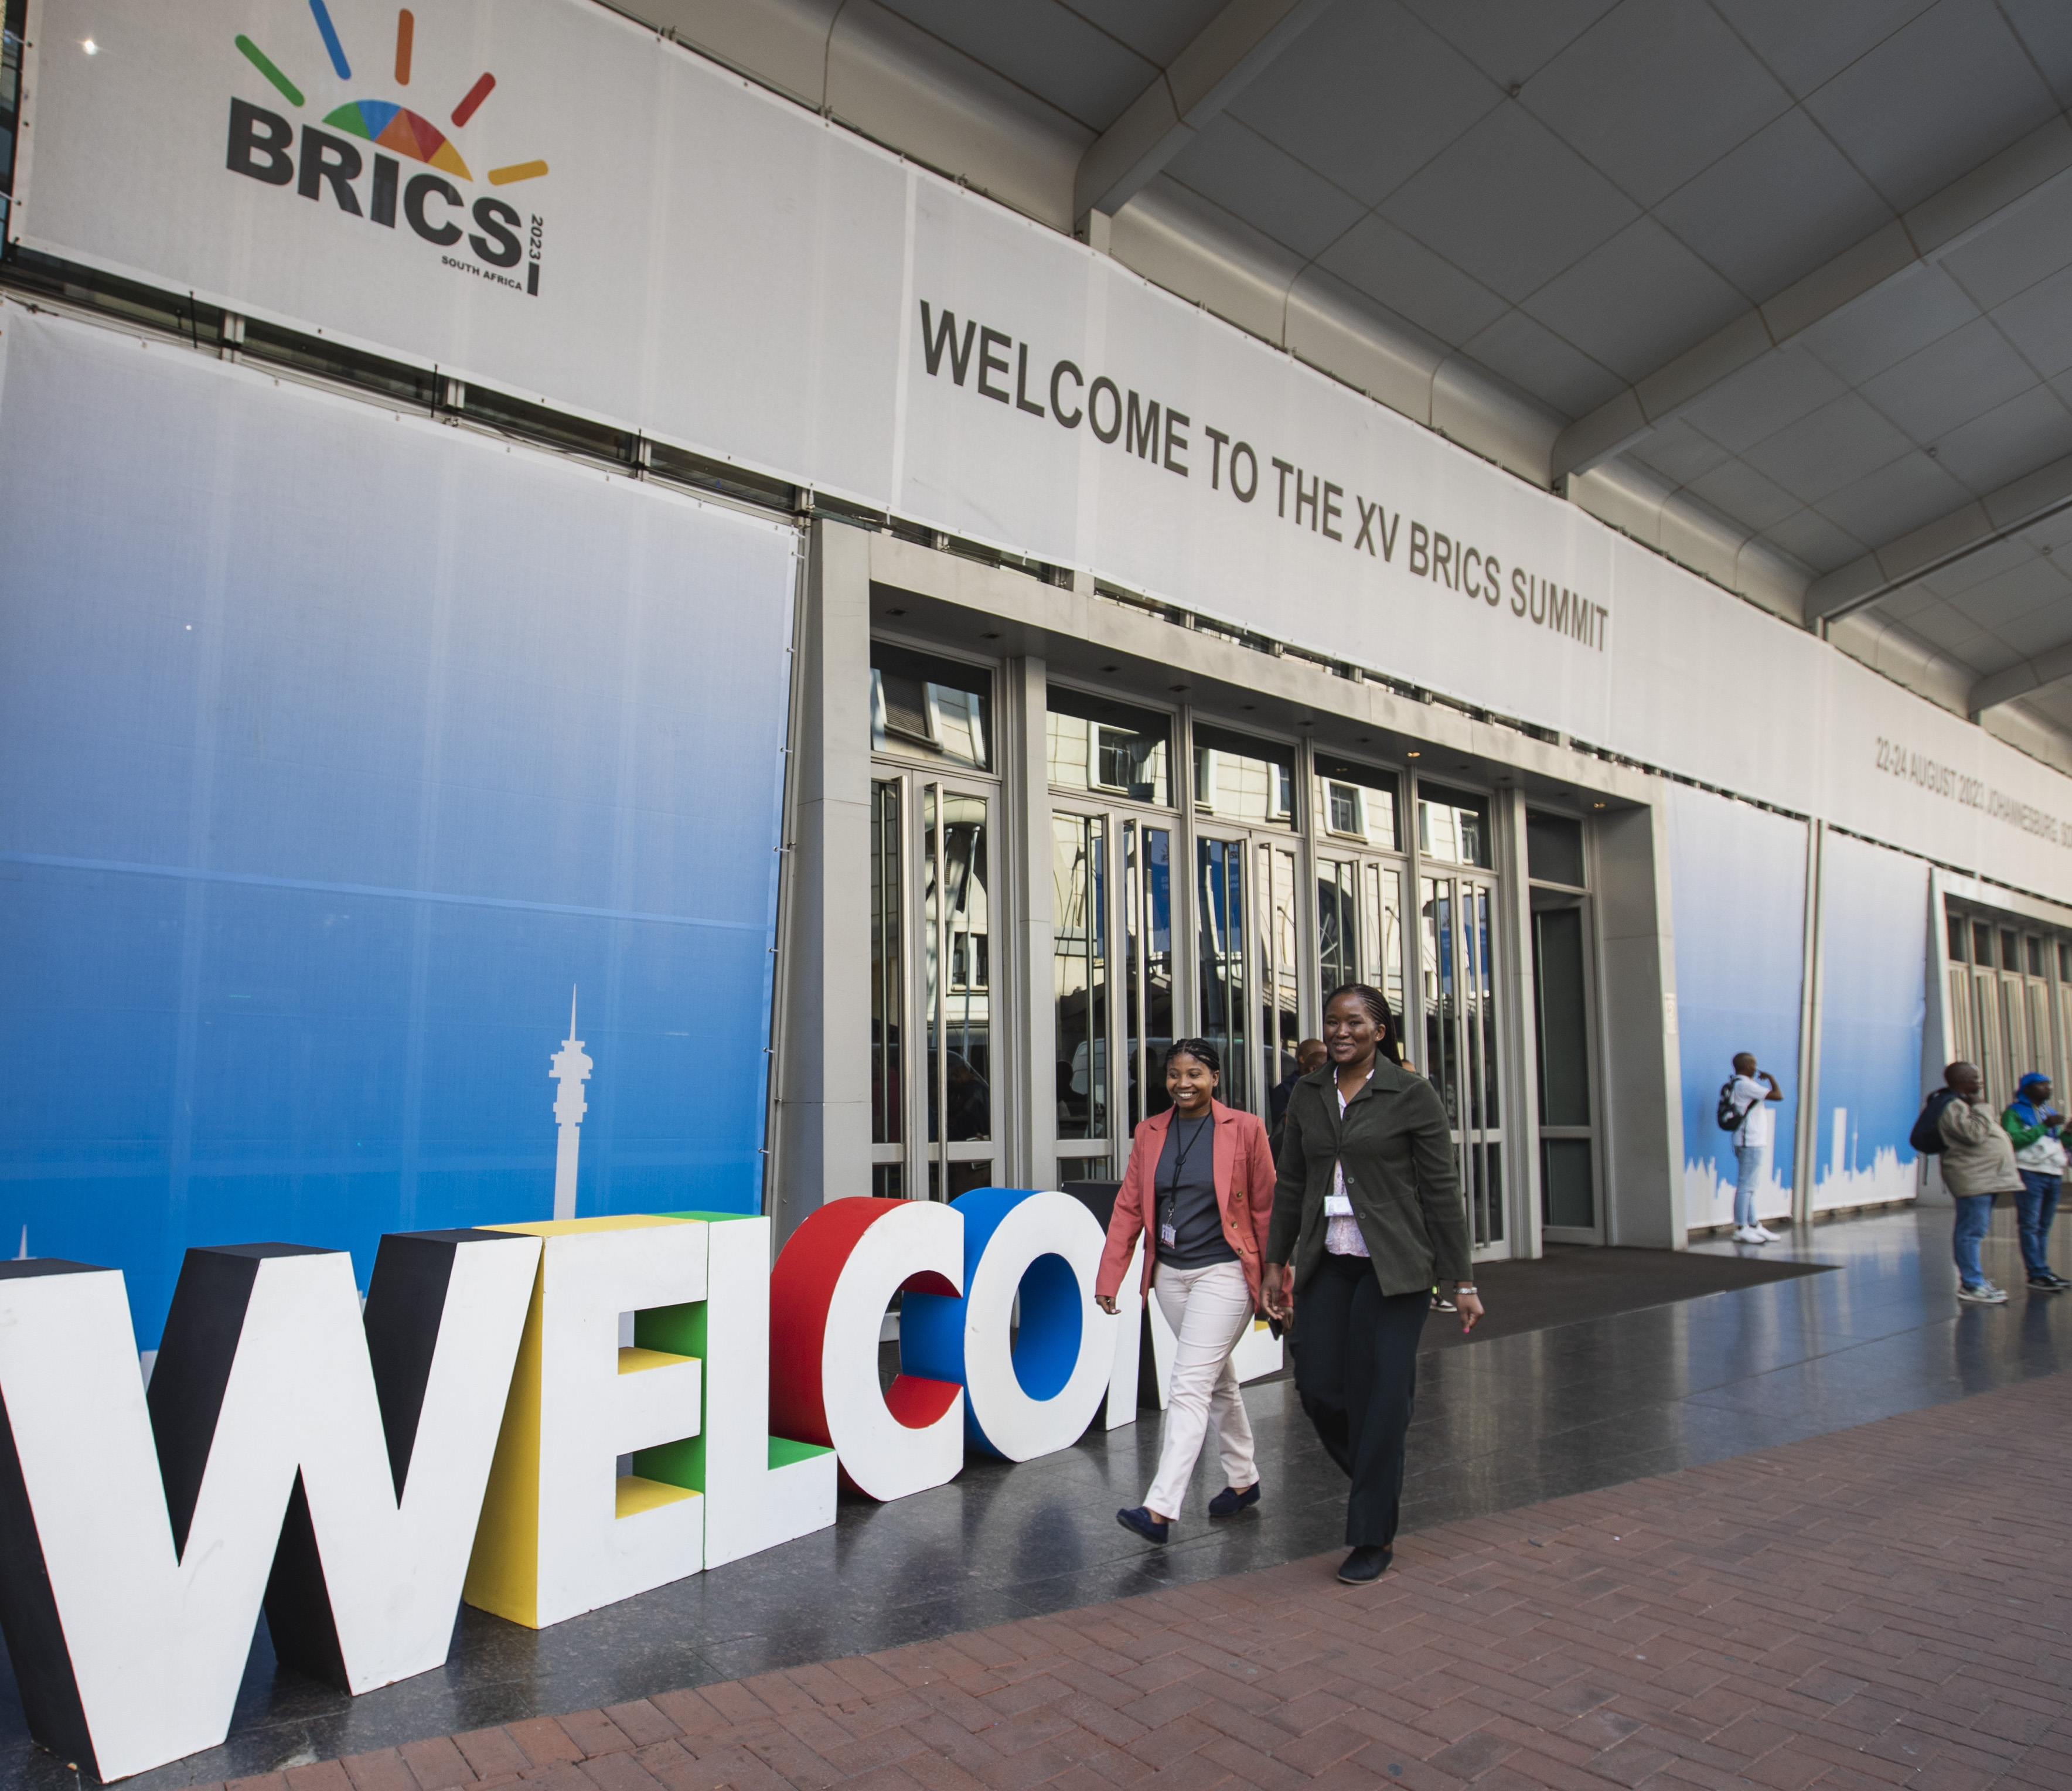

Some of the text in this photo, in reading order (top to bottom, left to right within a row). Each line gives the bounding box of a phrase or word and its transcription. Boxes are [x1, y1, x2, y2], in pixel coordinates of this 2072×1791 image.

[226, 97, 523, 268] BRICS
[529, 214, 543, 260] 2023
[442, 255, 523, 291] SOUTH AFRICA
[919, 299, 1608, 652] WELCOME TO THE XV BRICS SUMMIT
[1876, 736, 1907, 779] 22-24
[1909, 753, 1957, 799] AUGUST
[0, 1187, 1283, 1783] WELCO
